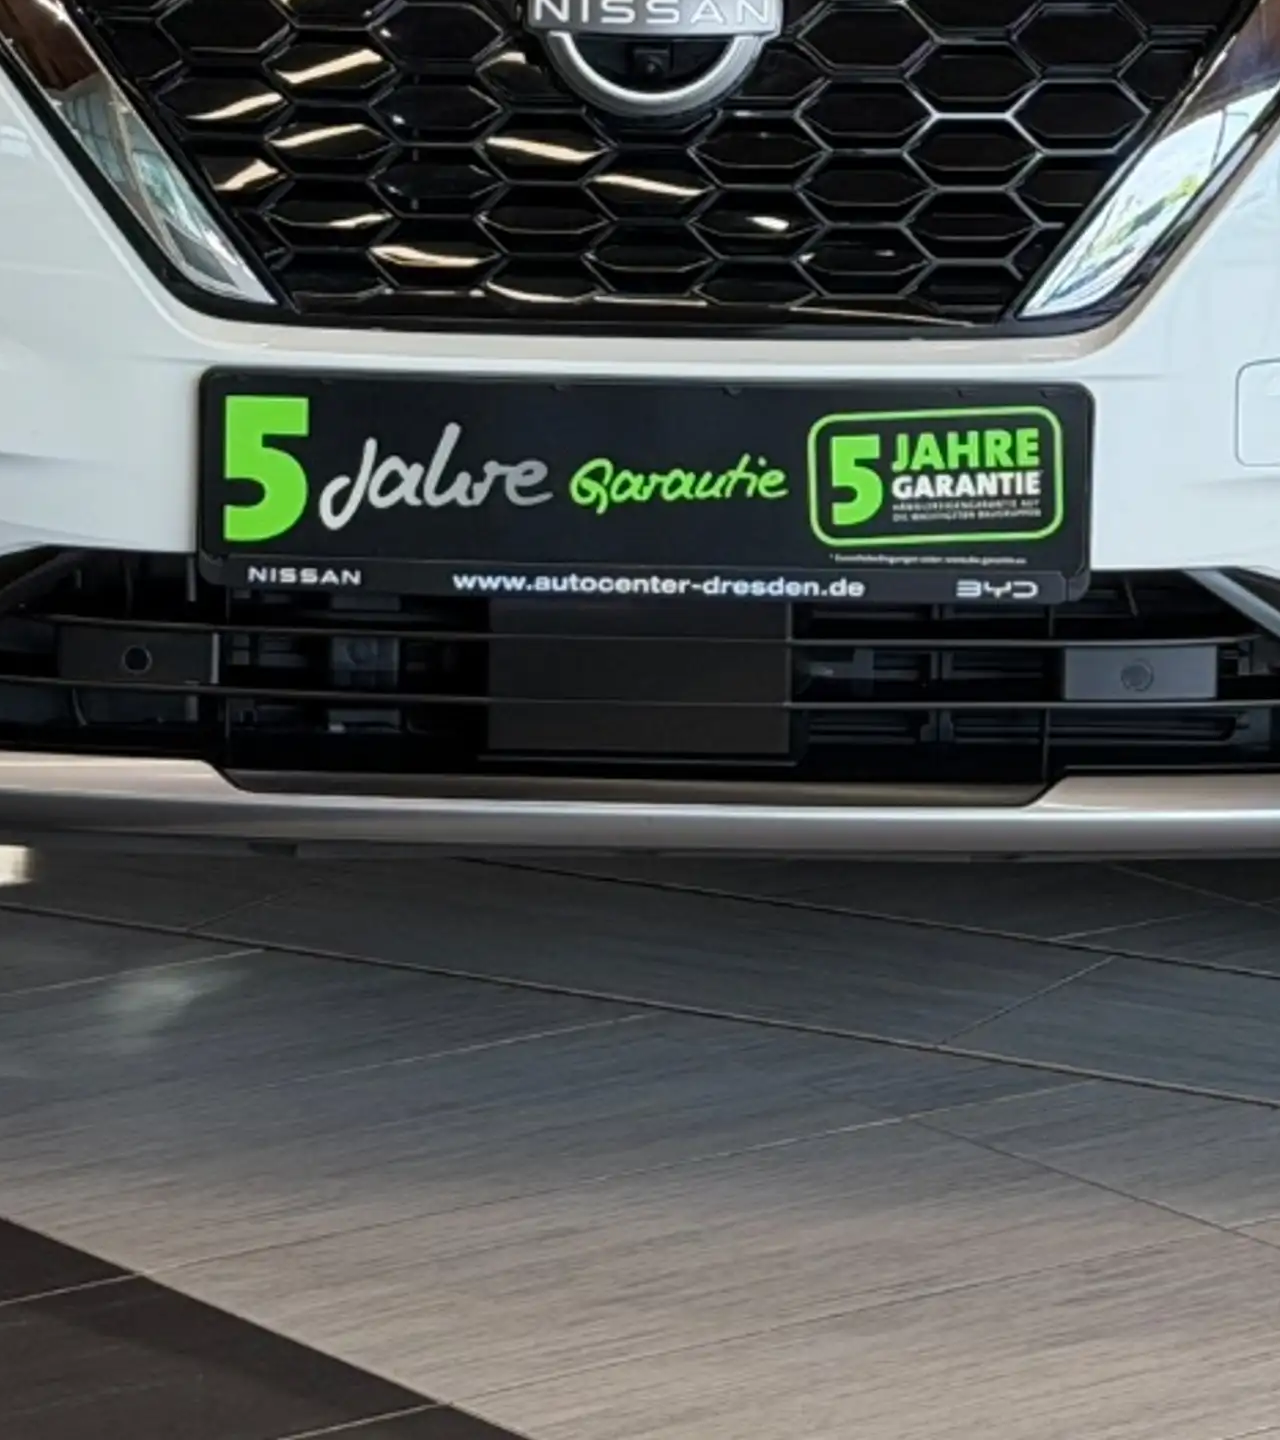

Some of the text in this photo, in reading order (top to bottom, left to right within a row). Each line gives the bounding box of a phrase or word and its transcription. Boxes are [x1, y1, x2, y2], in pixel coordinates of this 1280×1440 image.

[224, 395, 789, 542] 5 Jahre Garantie
[830, 427, 1040, 526] 5 JAHRE
[248, 565, 362, 586] NISSAN
[453, 573, 867, 598] www.autocenter-dresden.de
[956, 579, 1039, 599] BYD
